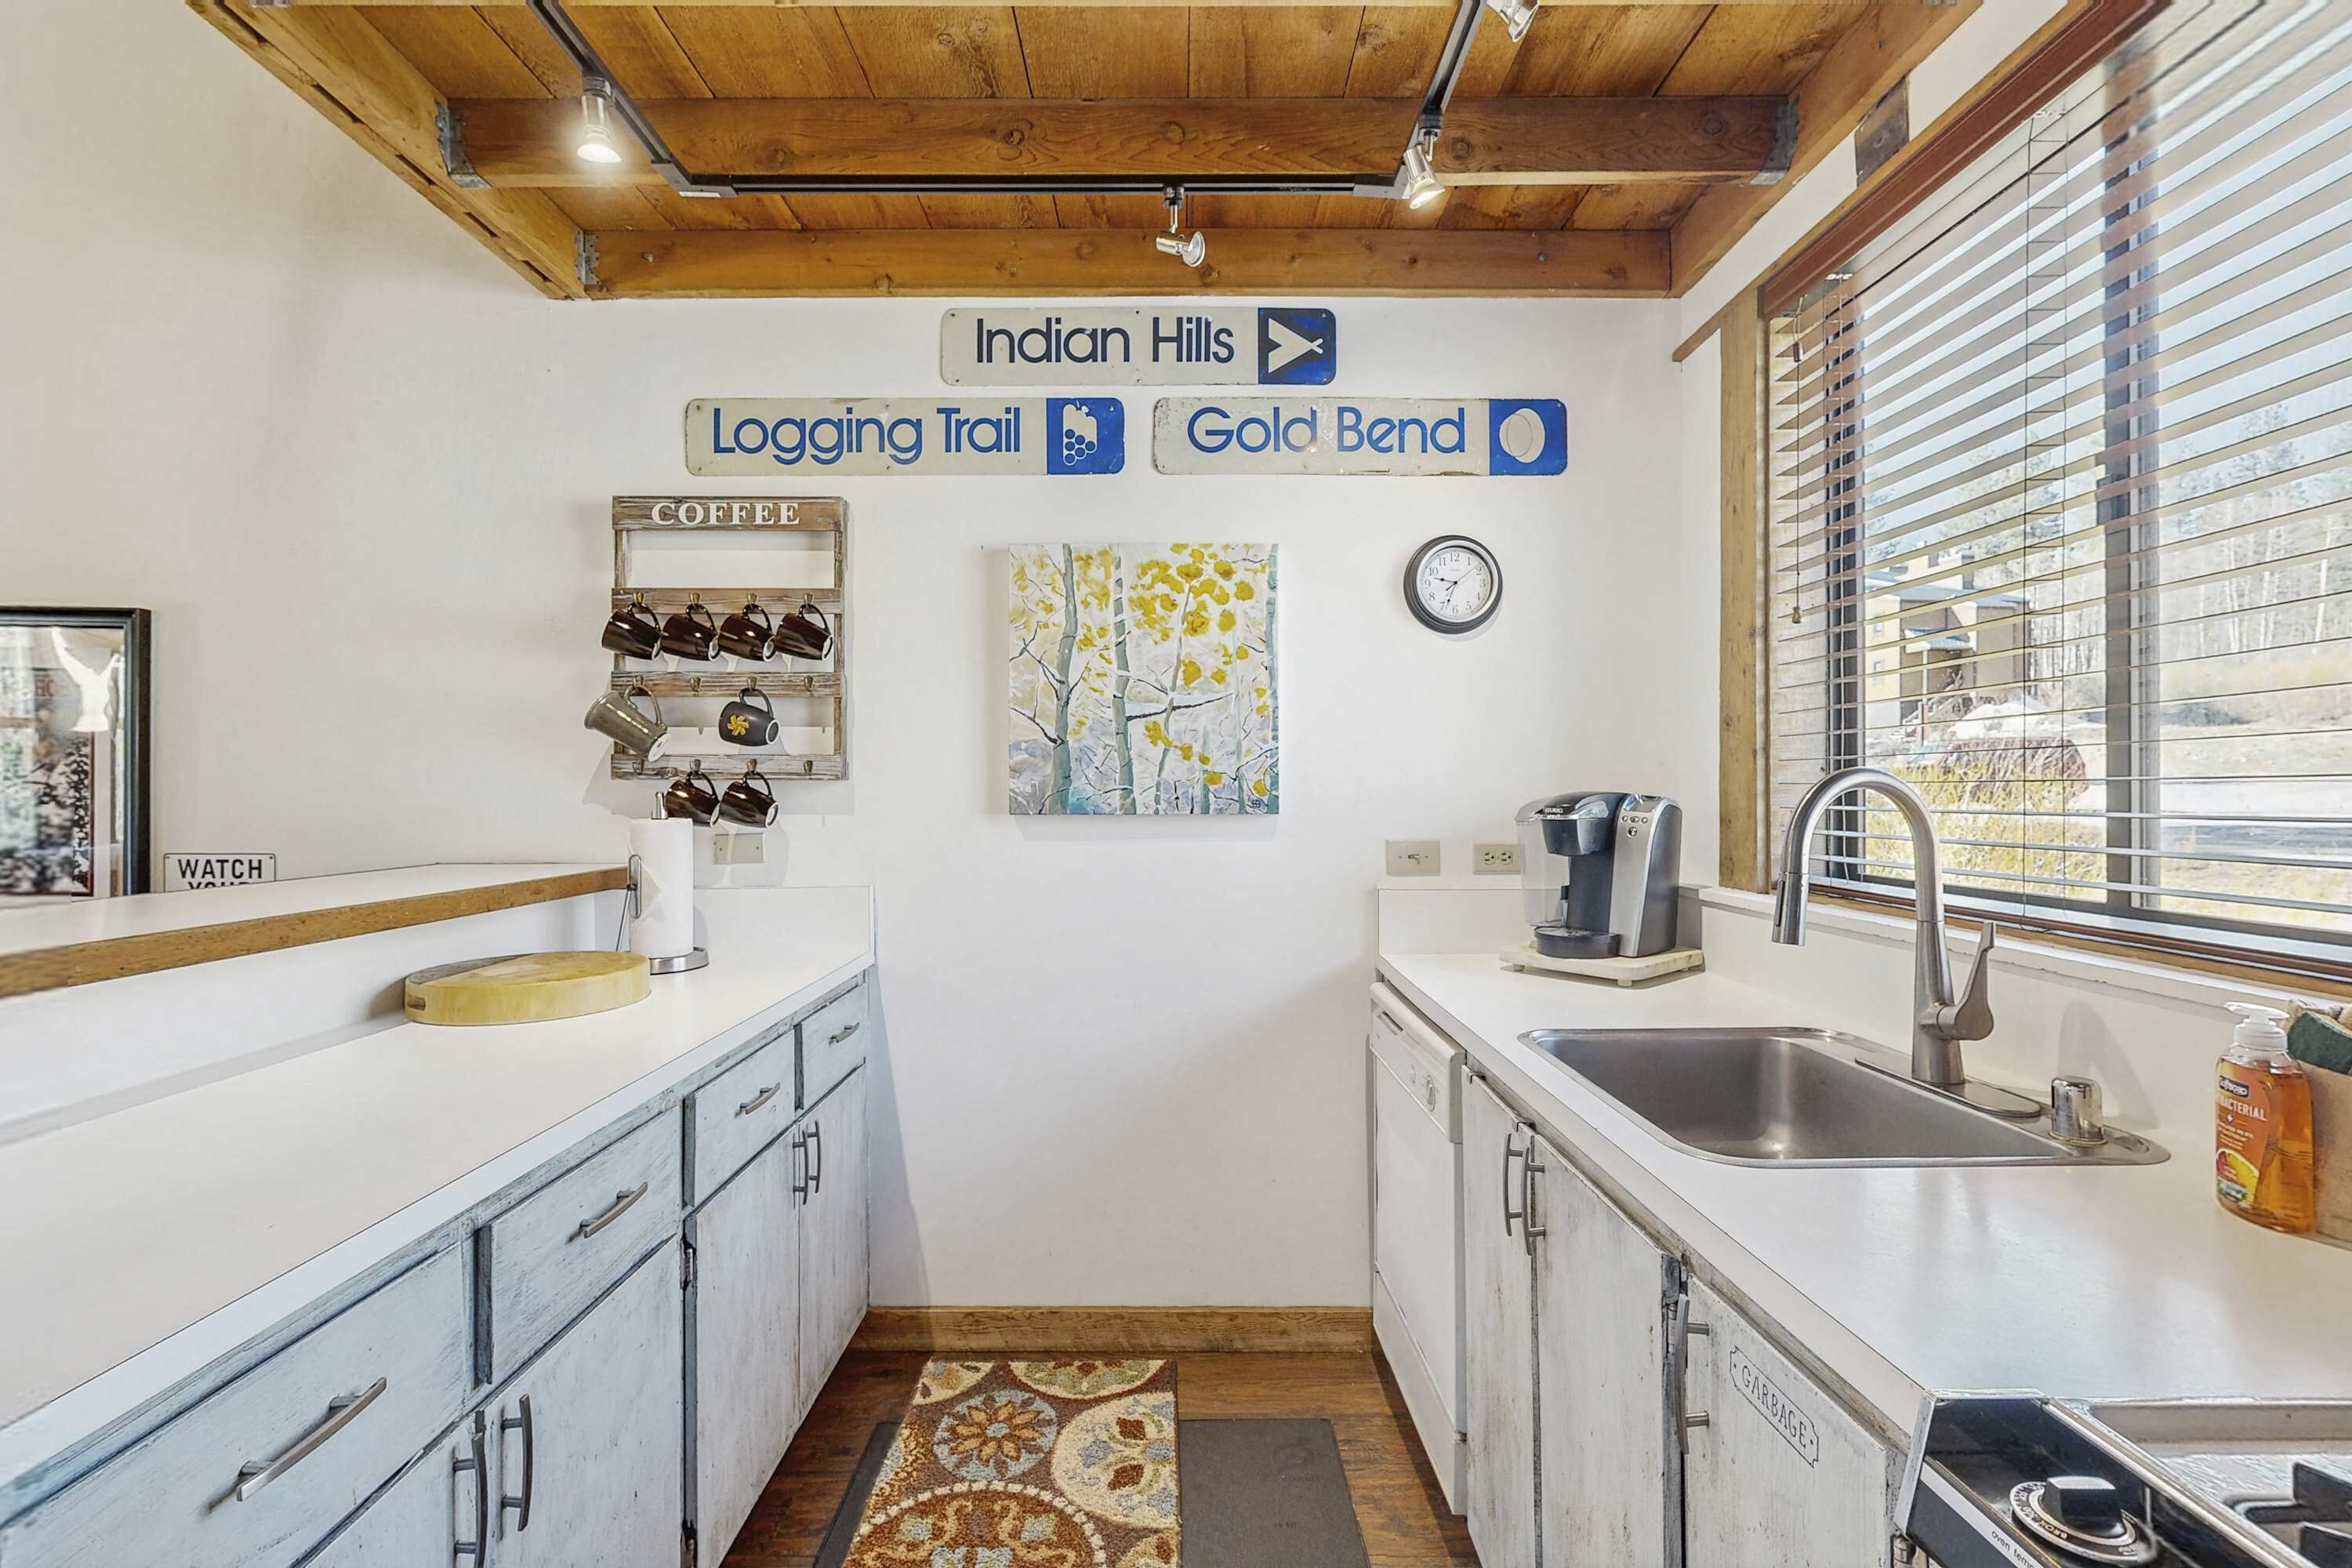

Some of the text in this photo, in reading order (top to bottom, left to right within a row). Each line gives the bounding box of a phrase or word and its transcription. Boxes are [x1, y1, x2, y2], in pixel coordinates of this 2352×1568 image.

[976, 316, 1235, 364] Indian Hills
[713, 407, 1020, 466] Logging Trail
[1187, 406, 1465, 454] Gold Bend
[651, 502, 800, 525] COFFEE
[1450, 551, 1461, 562] 12
[1429, 567, 1439, 577] 10
[177, 858, 263, 879] WATCH
[1741, 1365, 1806, 1450] GARBAGE
[1991, 1530, 2011, 1552] oven
